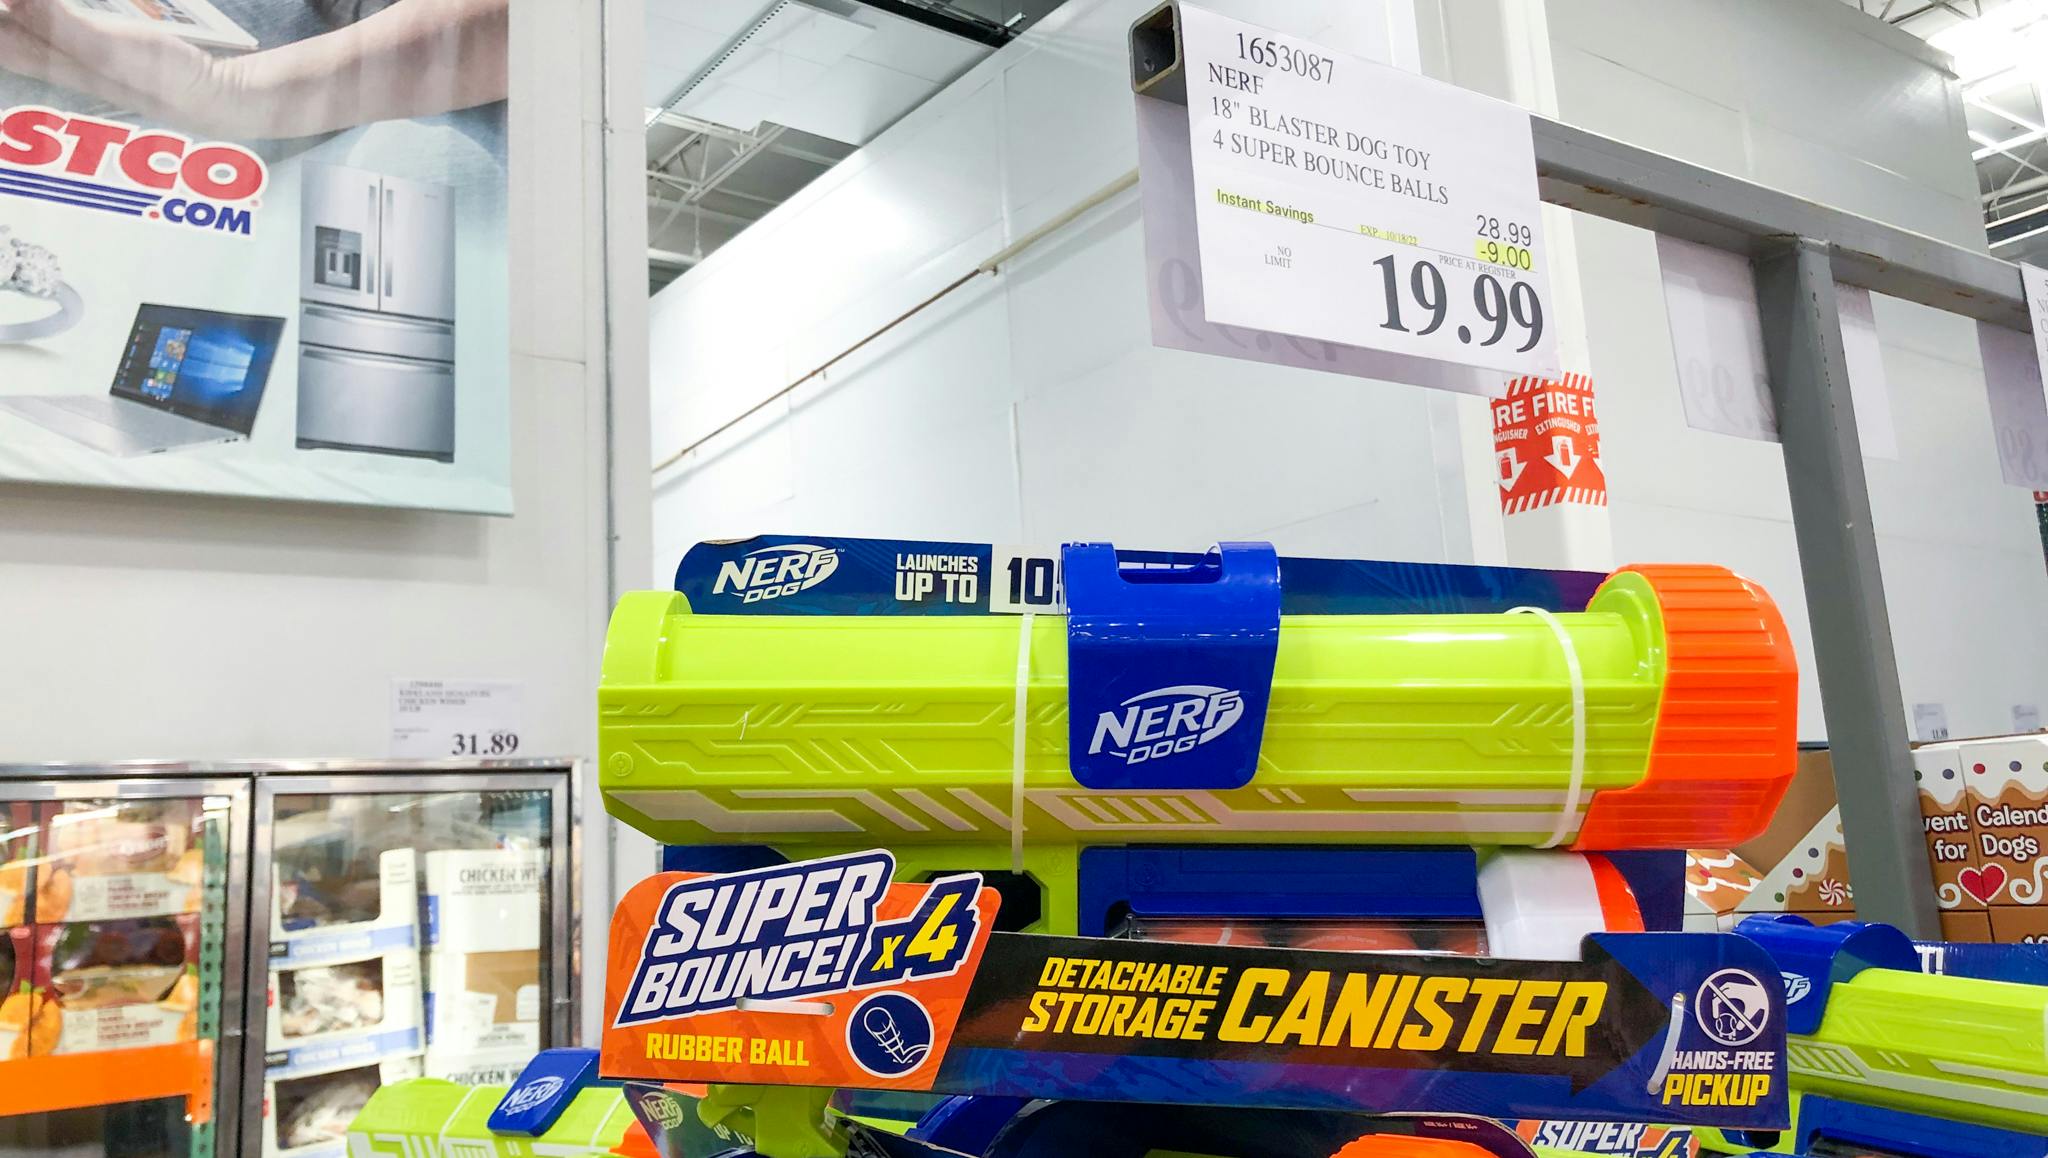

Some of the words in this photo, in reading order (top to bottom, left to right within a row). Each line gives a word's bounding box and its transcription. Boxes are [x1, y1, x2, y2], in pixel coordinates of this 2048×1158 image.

[1236, 32, 1334, 84] 1653087
[1209, 62, 1264, 95] NERF
[1211, 96, 1240, 120] 18"
[1249, 105, 1339, 147] BLASTER
[1346, 131, 1388, 161] DOG
[1393, 143, 1431, 171] TOY
[0, 110, 263, 201] STCO
[1213, 129, 1225, 150] 4
[1231, 132, 1297, 168] SUPER
[1304, 151, 1385, 191] BOUNCE
[1391, 174, 1449, 205] BALLS
[149, 199, 250, 235] .COM
[1217, 189, 1261, 212] Instant
[1266, 200, 1314, 224] Savings
[1477, 214, 1532, 247] 28.99
[1264, 254, 1292, 269] LIMIT
[1277, 246, 1292, 258] NO
[1439, 254, 1464, 269] PRICE
[1466, 260, 1477, 272] AT
[1478, 263, 1516, 279] REGISTER
[1481, 241, 1531, 270] -9.00
[1373, 253, 1543, 353] 19.99
[1492, 400, 1526, 428] RE
[1532, 391, 1579, 417] FIRE
[1535, 417, 1581, 436] EXTINGUISHER
[712, 546, 839, 594] NERF
[896, 552, 978, 573] LAUNCHES
[743, 583, 802, 604] DOG
[895, 572, 932, 602] UP
[942, 575, 977, 604] TO
[1007, 556, 1064, 606] 10
[1088, 687, 1244, 756] NERF
[452, 732, 519, 756] 31.89
[1127, 738, 1197, 765] DOG
[1935, 839, 1967, 860] for
[1981, 834, 2038, 861] Dogs
[652, 861, 886, 958] SUPER
[631, 934, 860, 1015] BOUNCE!
[1038, 957, 1228, 994] DETACHABLE
[1021, 991, 1217, 1041] STORAGE
[1217, 967, 1607, 1057] CANISTER
[646, 1032, 743, 1064] RUBBER
[749, 1040, 810, 1067] BALL
[1670, 1051, 1775, 1070] HANDS-FREE
[1662, 1073, 1770, 1106] PICKUP
[1539, 1120, 1643, 1150] SUPER
